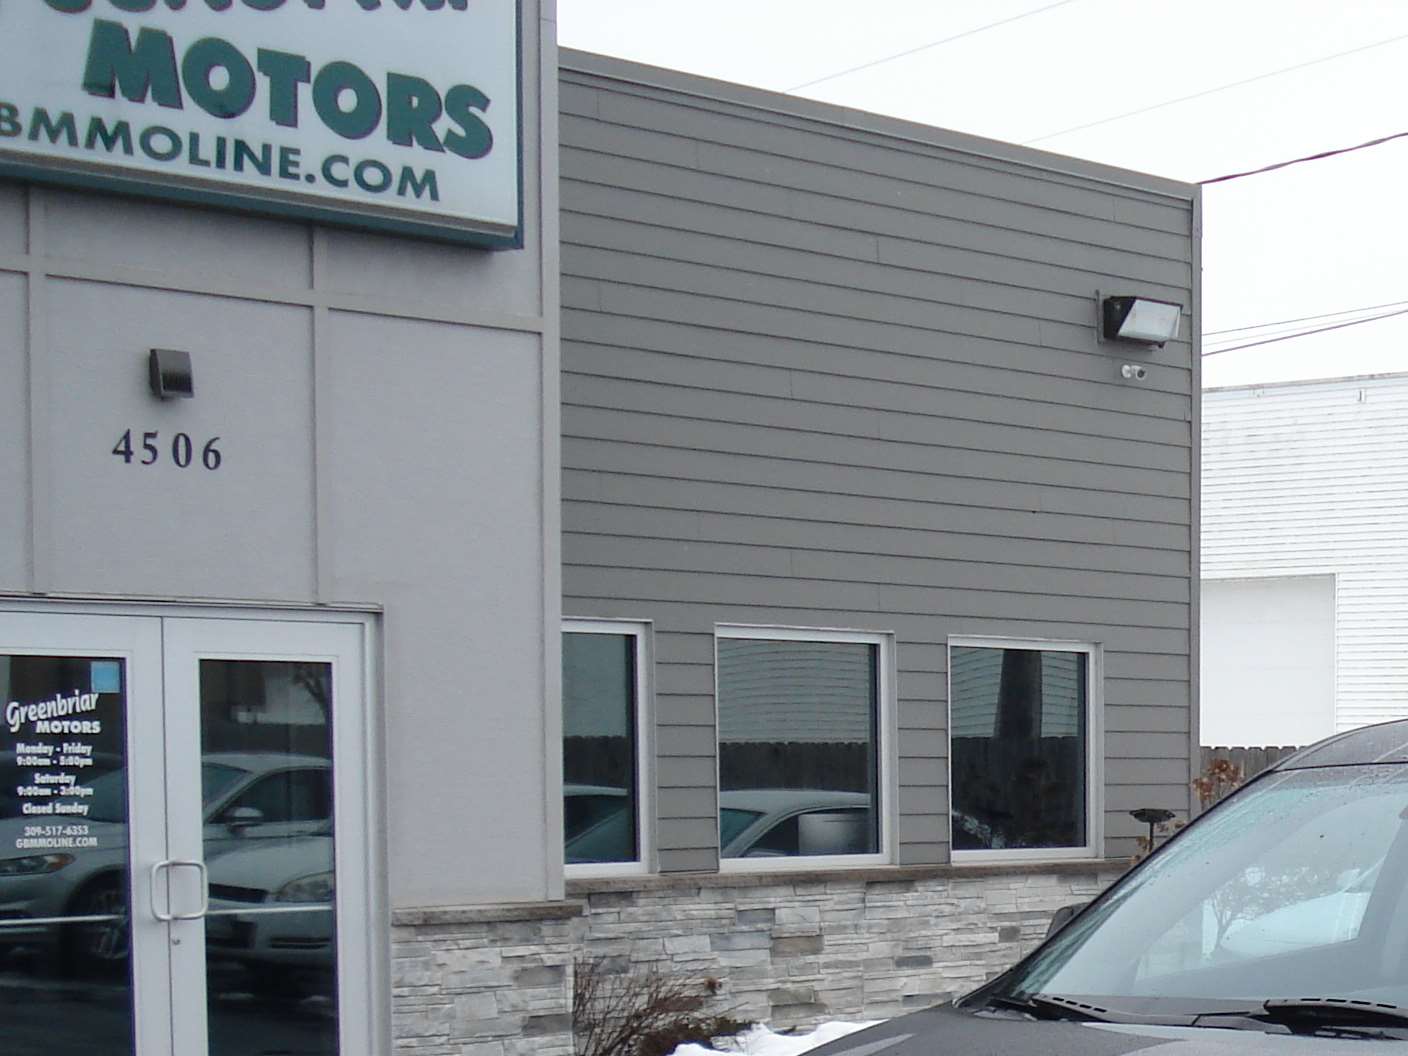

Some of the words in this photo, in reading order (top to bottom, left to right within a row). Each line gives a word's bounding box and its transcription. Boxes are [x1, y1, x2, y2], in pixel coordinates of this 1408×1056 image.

[83, 18, 494, 160] MOTORS
[112, 428, 222, 471] 4506
[6, 689, 99, 733] Greenbriar
[36, 720, 101, 734] MOTORS
[16, 742, 54, 756] Monday
[62, 742, 93, 756] Friday
[16, 756, 51, 767] 9:00am
[34, 772, 76, 786] Saturday
[22, 802, 53, 814] Closed
[55, 802, 89, 816] Sunday
[24, 825, 89, 837] 309-517-6353
[16, 837, 98, 849] GBMMOLINE.COM
